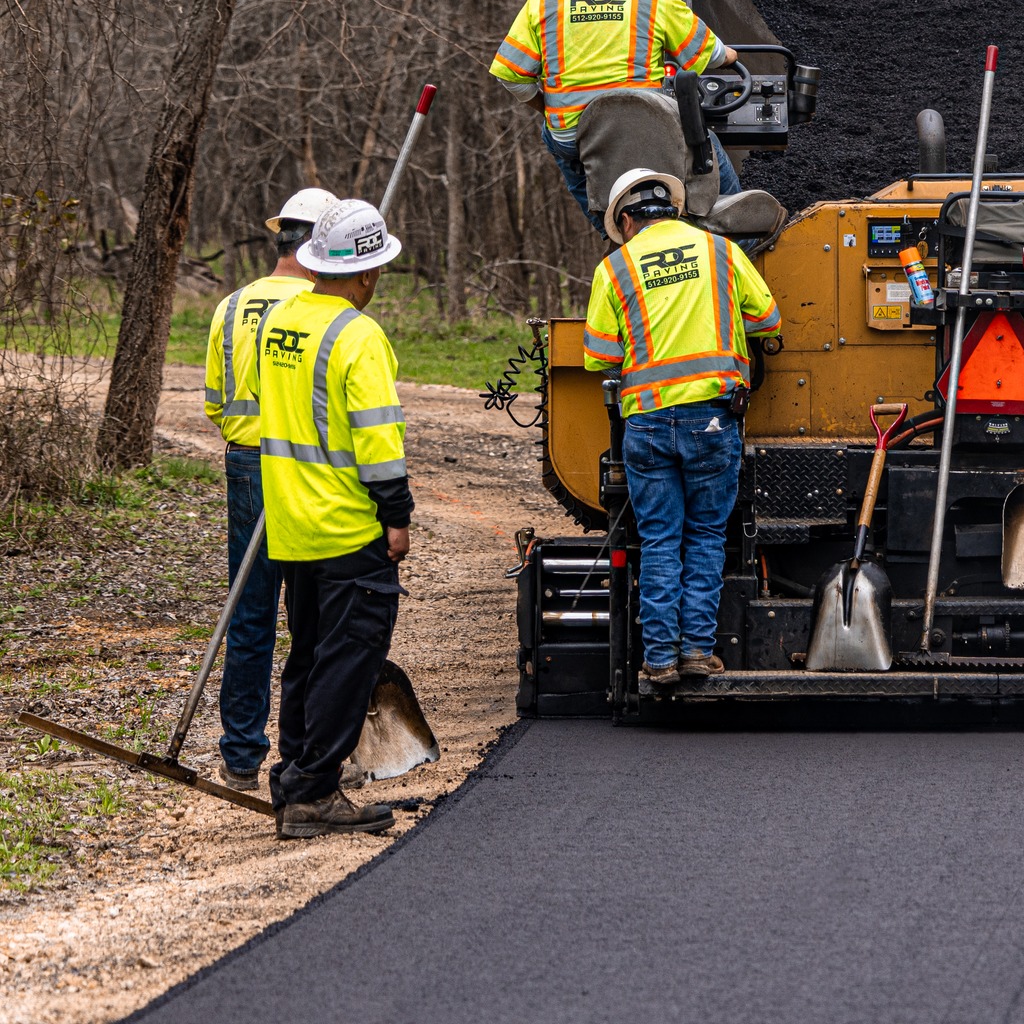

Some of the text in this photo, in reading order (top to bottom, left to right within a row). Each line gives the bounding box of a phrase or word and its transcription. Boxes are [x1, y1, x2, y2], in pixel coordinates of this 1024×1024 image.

[570, 5, 624, 13] PAVING
[572, 13, 622, 22] 512-920-9155
[357, 232, 382, 251] RDC
[639, 243, 699, 274] RDC
[643, 261, 699, 280] PAVING
[647, 270, 698, 289] 512-920-9155
[266, 327, 311, 354] RDC
[265, 348, 303, 363] PAVING
